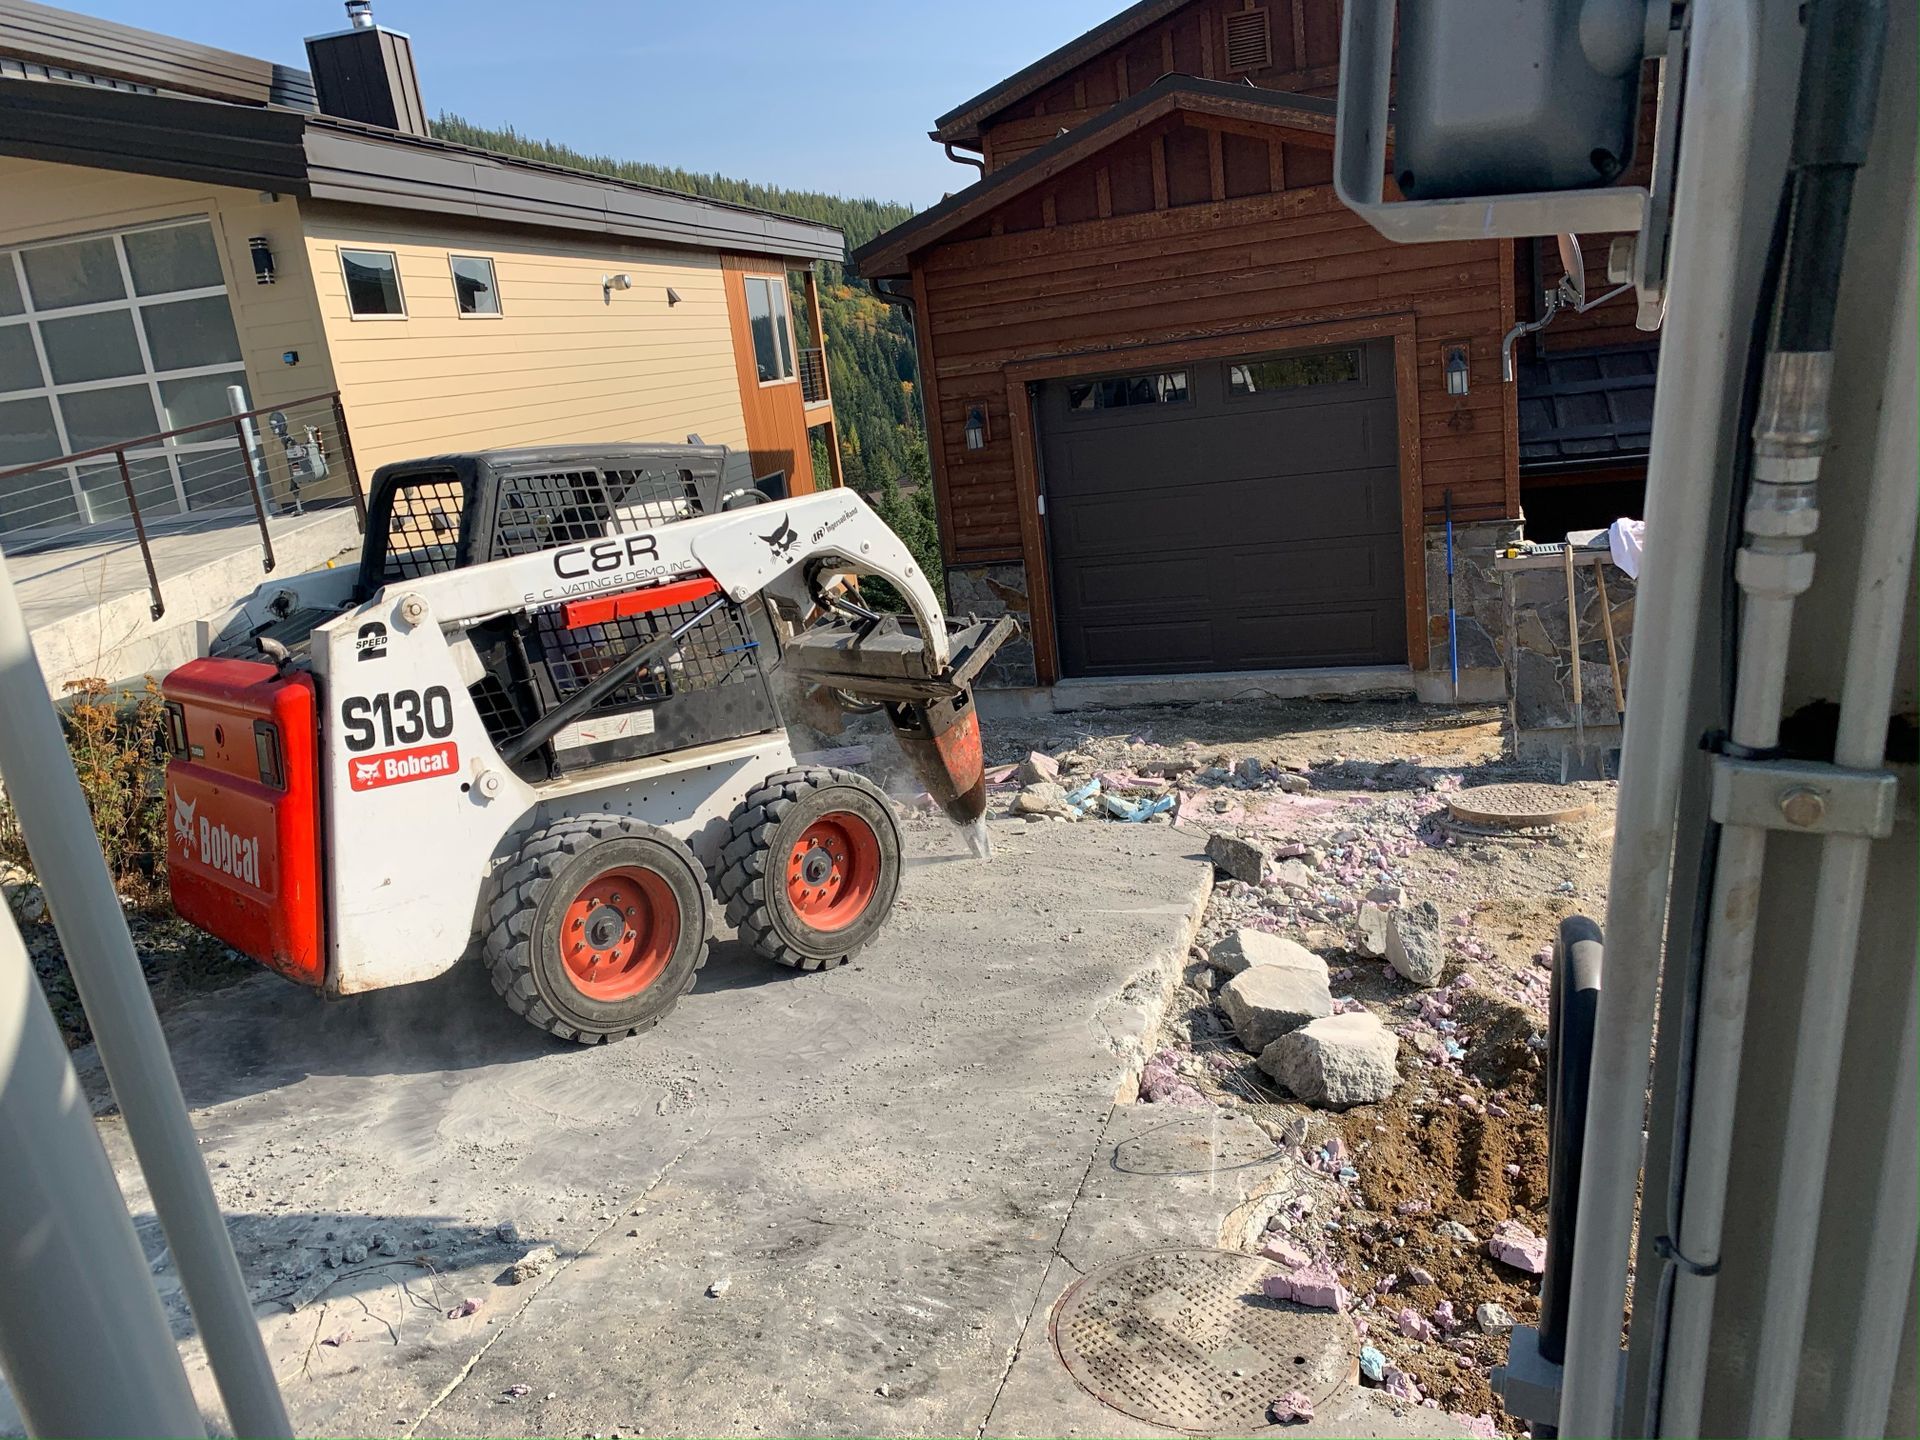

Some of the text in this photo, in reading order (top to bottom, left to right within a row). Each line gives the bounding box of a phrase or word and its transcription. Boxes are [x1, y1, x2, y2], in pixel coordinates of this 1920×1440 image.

[554, 534, 660, 579] C&R
[613, 572, 623, 584] &
[626, 565, 669, 582] DEMO,
[670, 559, 692, 572] INC
[355, 635, 388, 651] SPEED
[357, 621, 388, 662] 2
[341, 685, 454, 752] S130
[383, 750, 450, 780] Bobcat
[199, 816, 261, 888] Bobcat
